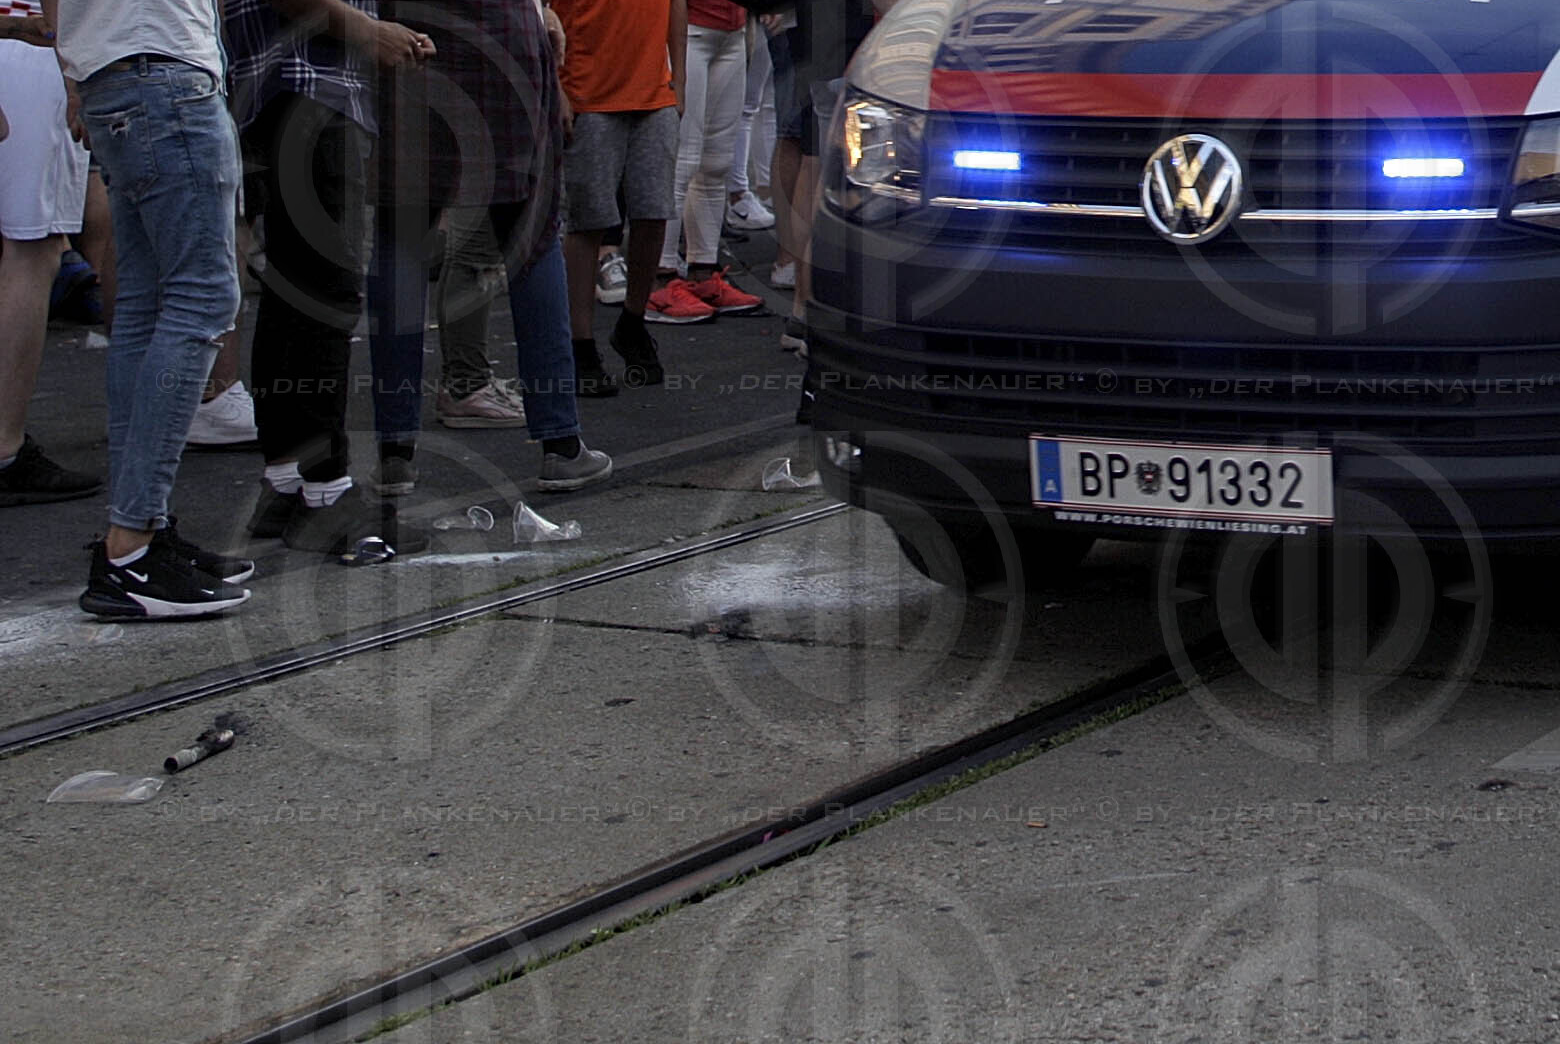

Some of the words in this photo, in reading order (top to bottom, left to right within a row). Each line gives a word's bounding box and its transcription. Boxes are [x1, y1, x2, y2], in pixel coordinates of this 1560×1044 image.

[1078, 451, 1131, 499] BP
[1167, 456, 1305, 509] 91332
[1054, 510, 1308, 536] WWW.PORSCHEWIENLIESING.AT
